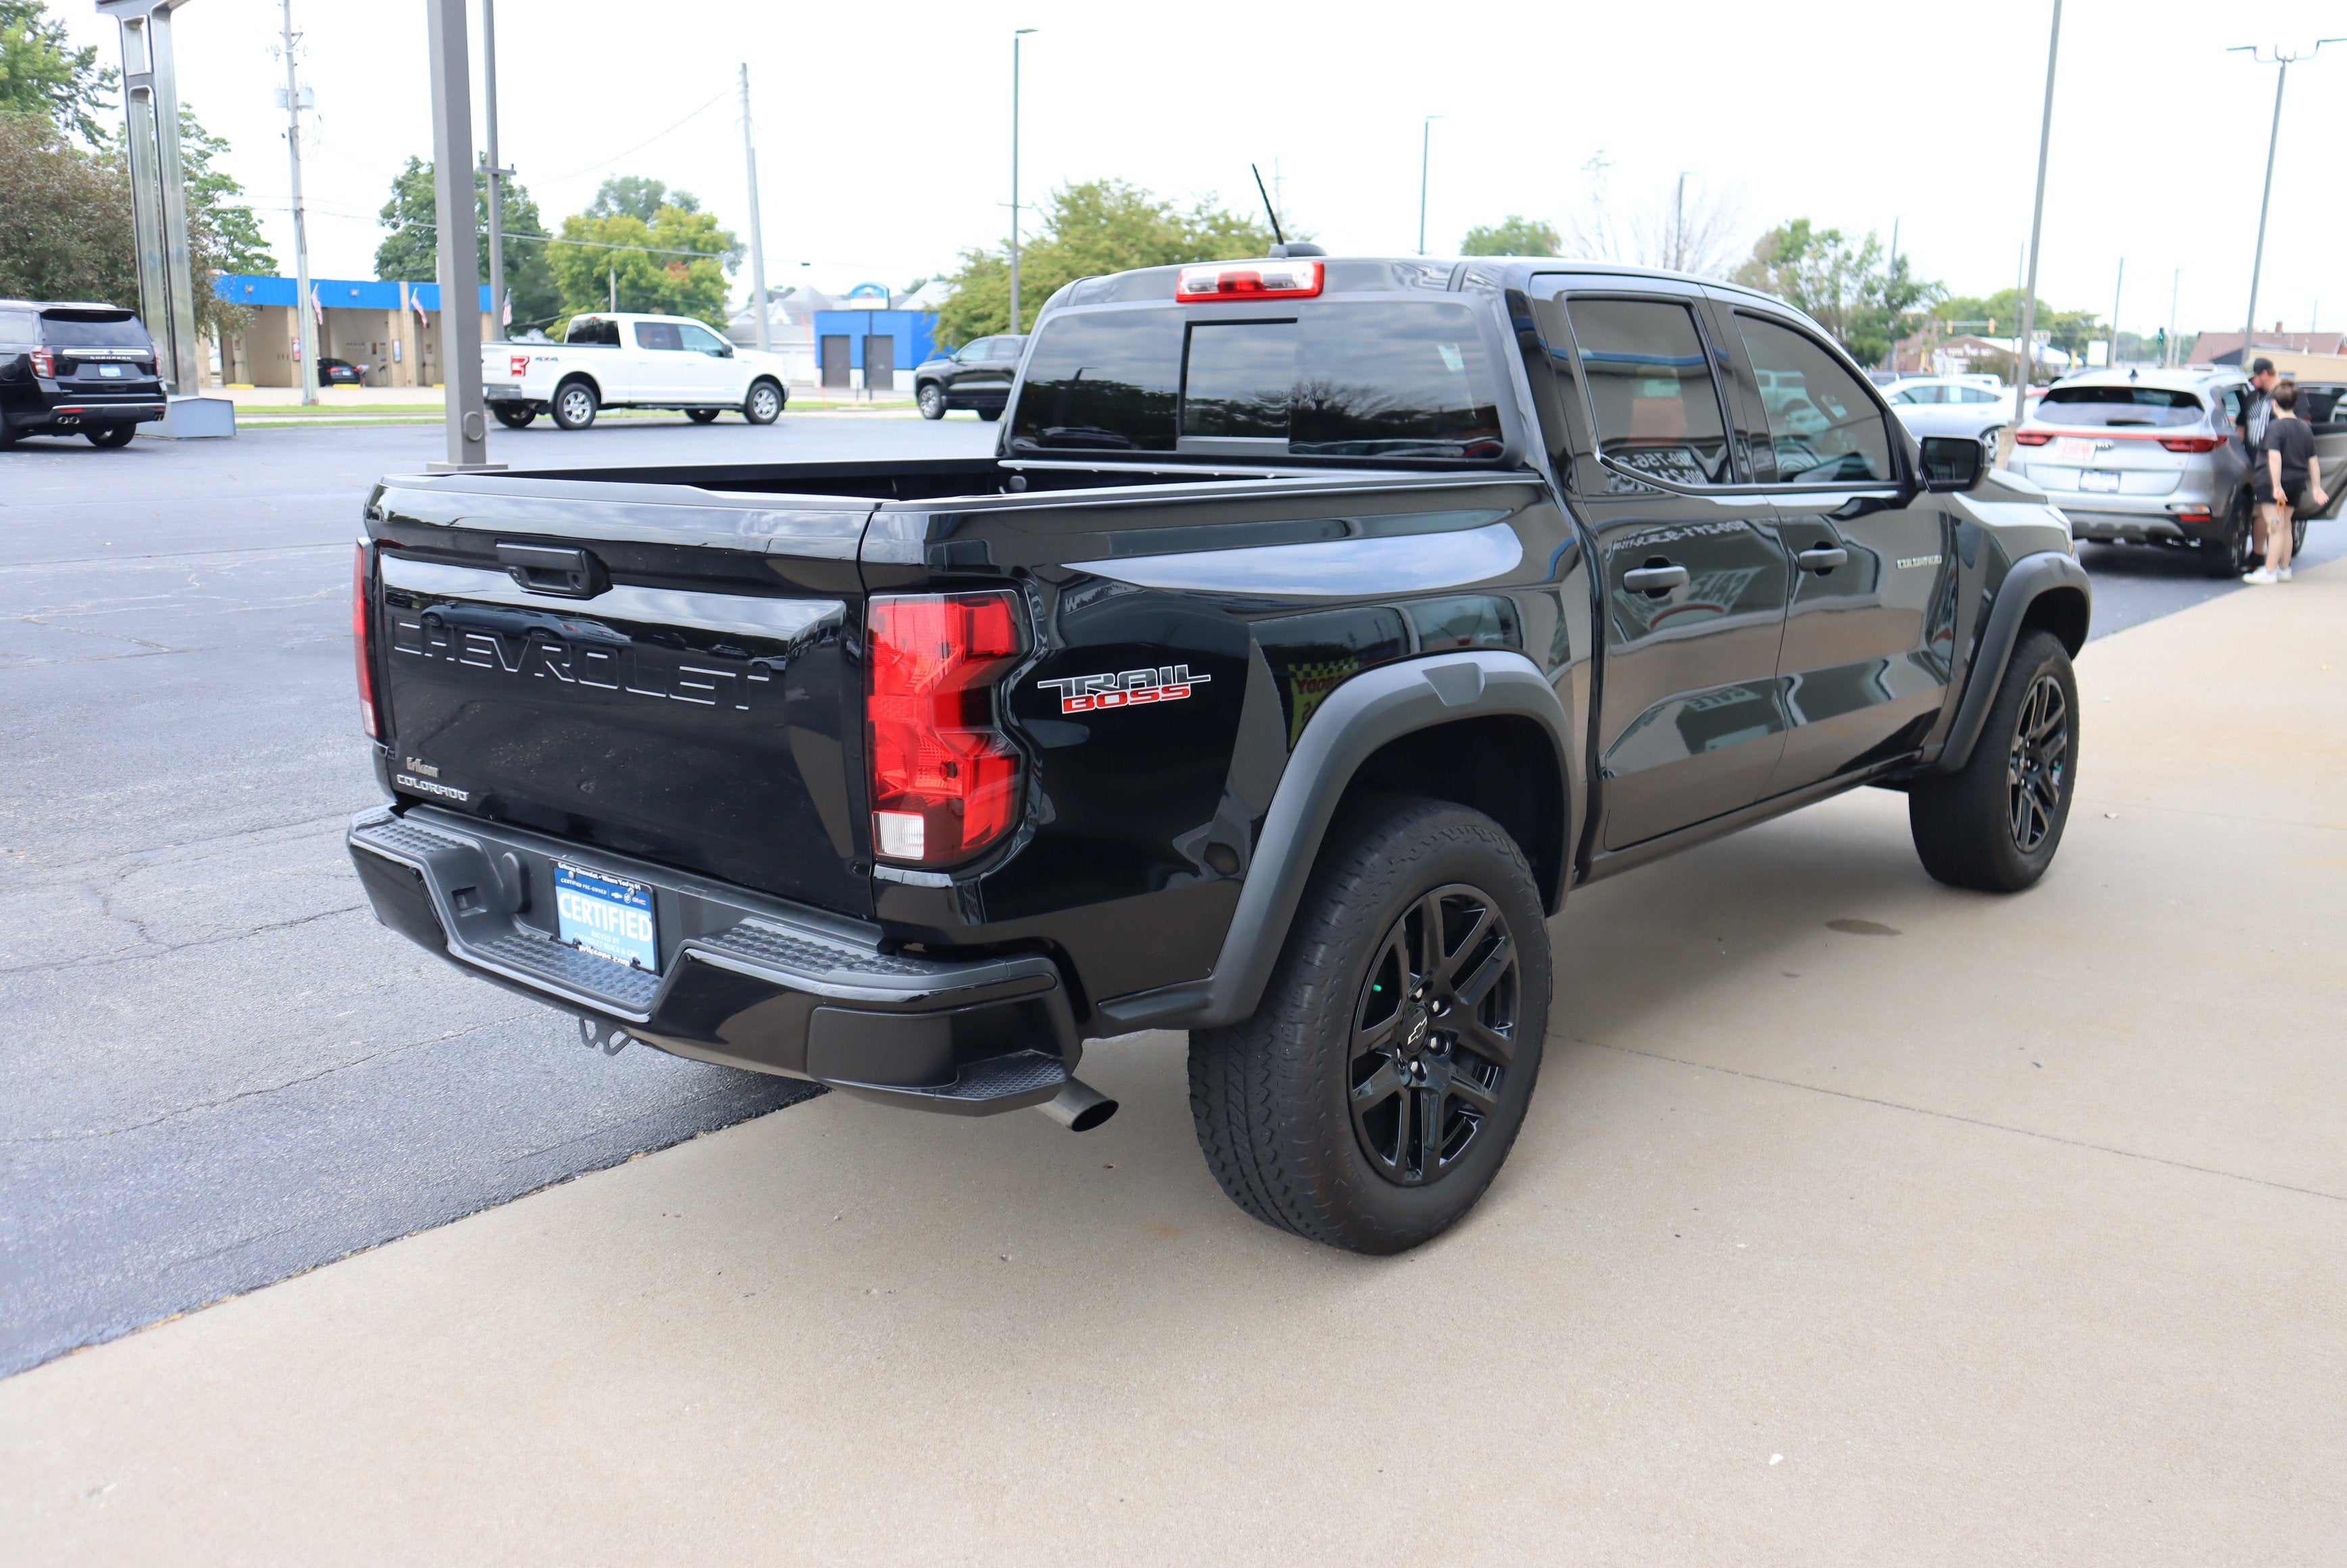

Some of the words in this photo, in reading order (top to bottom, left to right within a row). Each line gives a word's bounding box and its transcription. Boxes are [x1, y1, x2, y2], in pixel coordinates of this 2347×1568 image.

[392, 616, 769, 710] CHEVROLET
[1037, 664, 1211, 698] TRAIL
[1061, 683, 1191, 714] BOSS
[396, 774, 469, 802] COLORADO
[560, 878, 582, 888] CERTIFIED
[582, 884, 608, 896] PRE-OWNED
[559, 892, 653, 942] CERTIFIED
